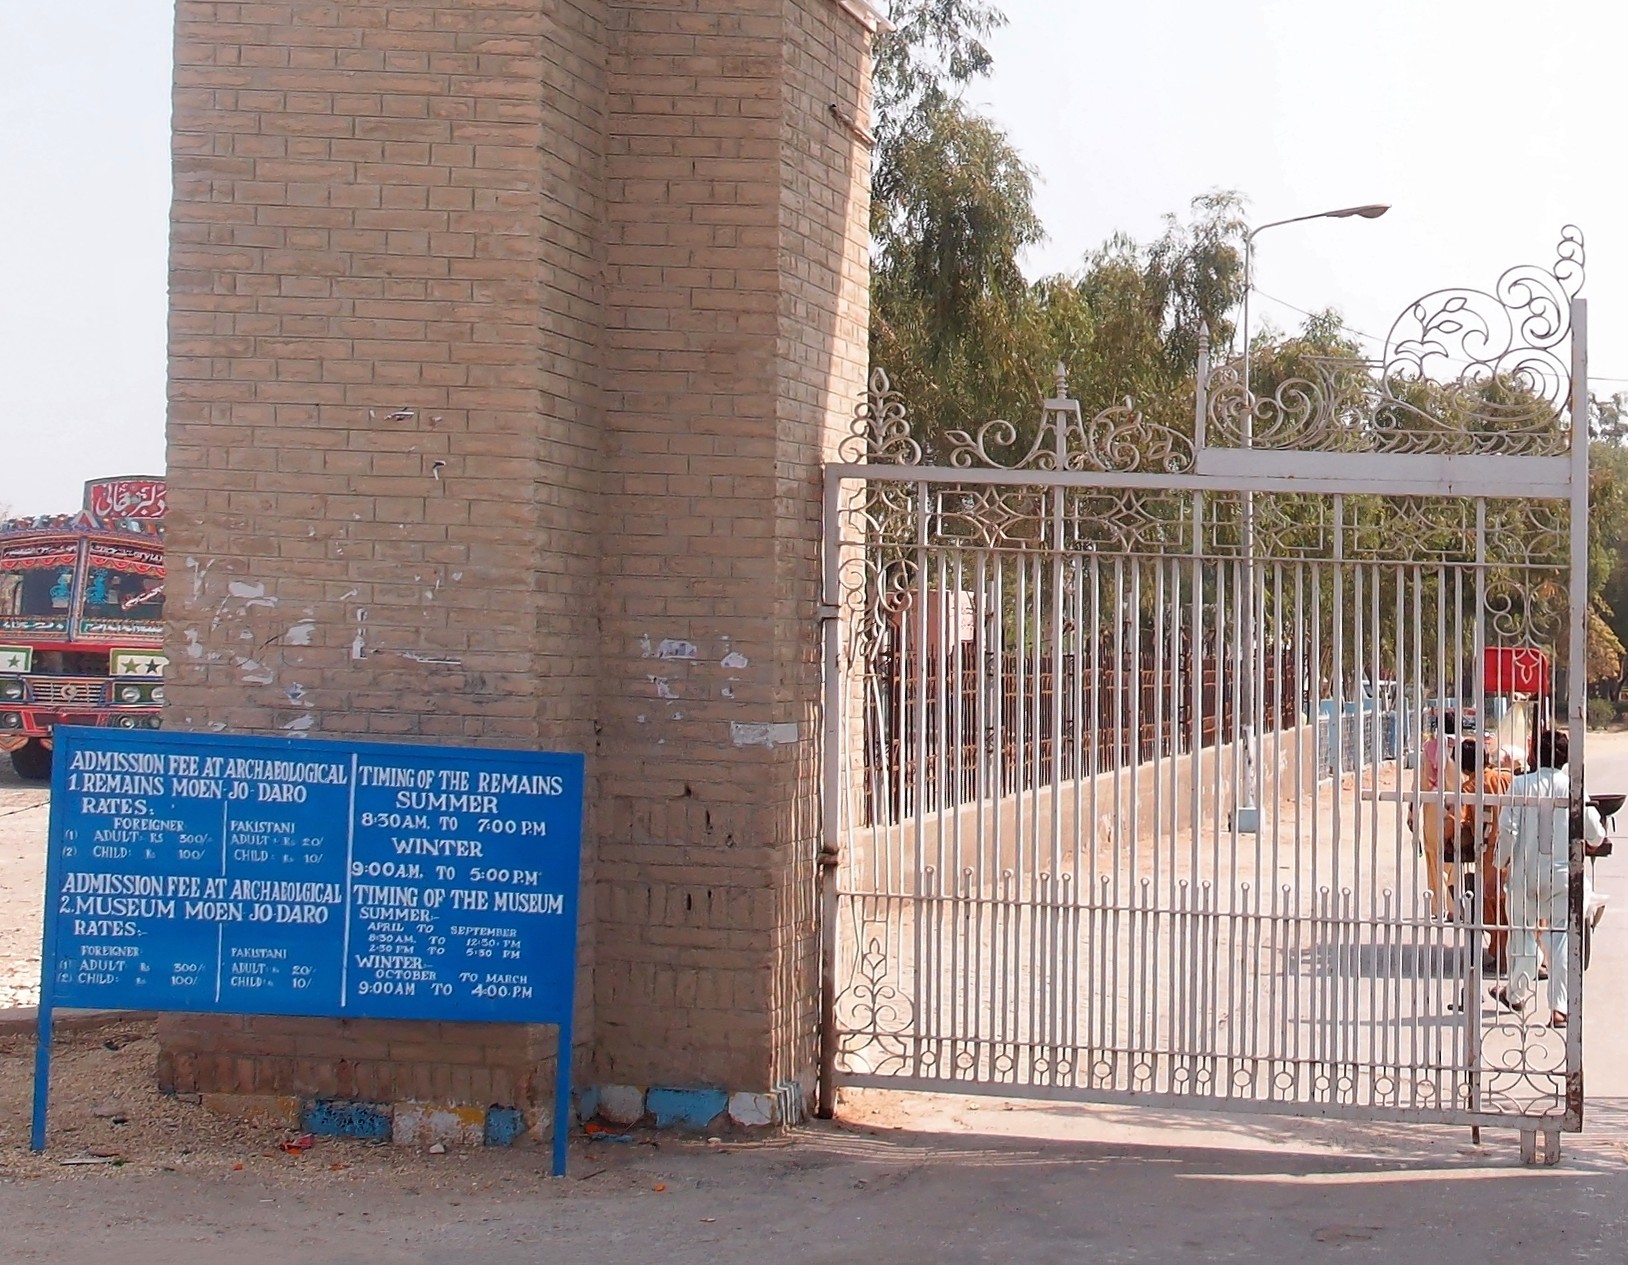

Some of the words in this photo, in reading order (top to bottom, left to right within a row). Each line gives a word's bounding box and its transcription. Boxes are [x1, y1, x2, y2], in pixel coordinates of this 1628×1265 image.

[70, 750, 164, 774] ADMISSION
[168, 756, 199, 776] FEE
[201, 756, 224, 776] AT
[224, 758, 347, 784] ARCHAEOLOGICAL
[82, 773, 164, 796] REMAINS
[358, 766, 415, 788] TIMING
[417, 770, 434, 789] OF
[438, 771, 469, 791] THE
[477, 773, 563, 796] REMAINS
[396, 791, 498, 814] SUMMER
[114, 818, 184, 832] FOREIGNER
[230, 820, 295, 833] PAKISTANI
[440, 816, 458, 830] TO
[392, 838, 483, 857] WINTER
[436, 866, 455, 880] TO
[62, 873, 163, 896] ADMISSION
[167, 877, 200, 898] FEE
[203, 878, 227, 899] AT
[354, 884, 418, 907] TIMING
[423, 889, 445, 908] OF
[450, 890, 488, 911] THE
[494, 892, 564, 915] MUSEUM
[75, 896, 175, 918] MUSEUM
[367, 923, 404, 932] APRIL
[416, 924, 434, 933] TO
[450, 926, 517, 937] SEPTEMBER
[428, 936, 446, 944] TO
[81, 946, 140, 957] FOREIGNER
[231, 948, 286, 959] PAKISTANI
[375, 969, 437, 980] OCTOBER
[458, 972, 478, 982] TO
[486, 973, 528, 984] MARCH
[430, 983, 453, 995] TO
